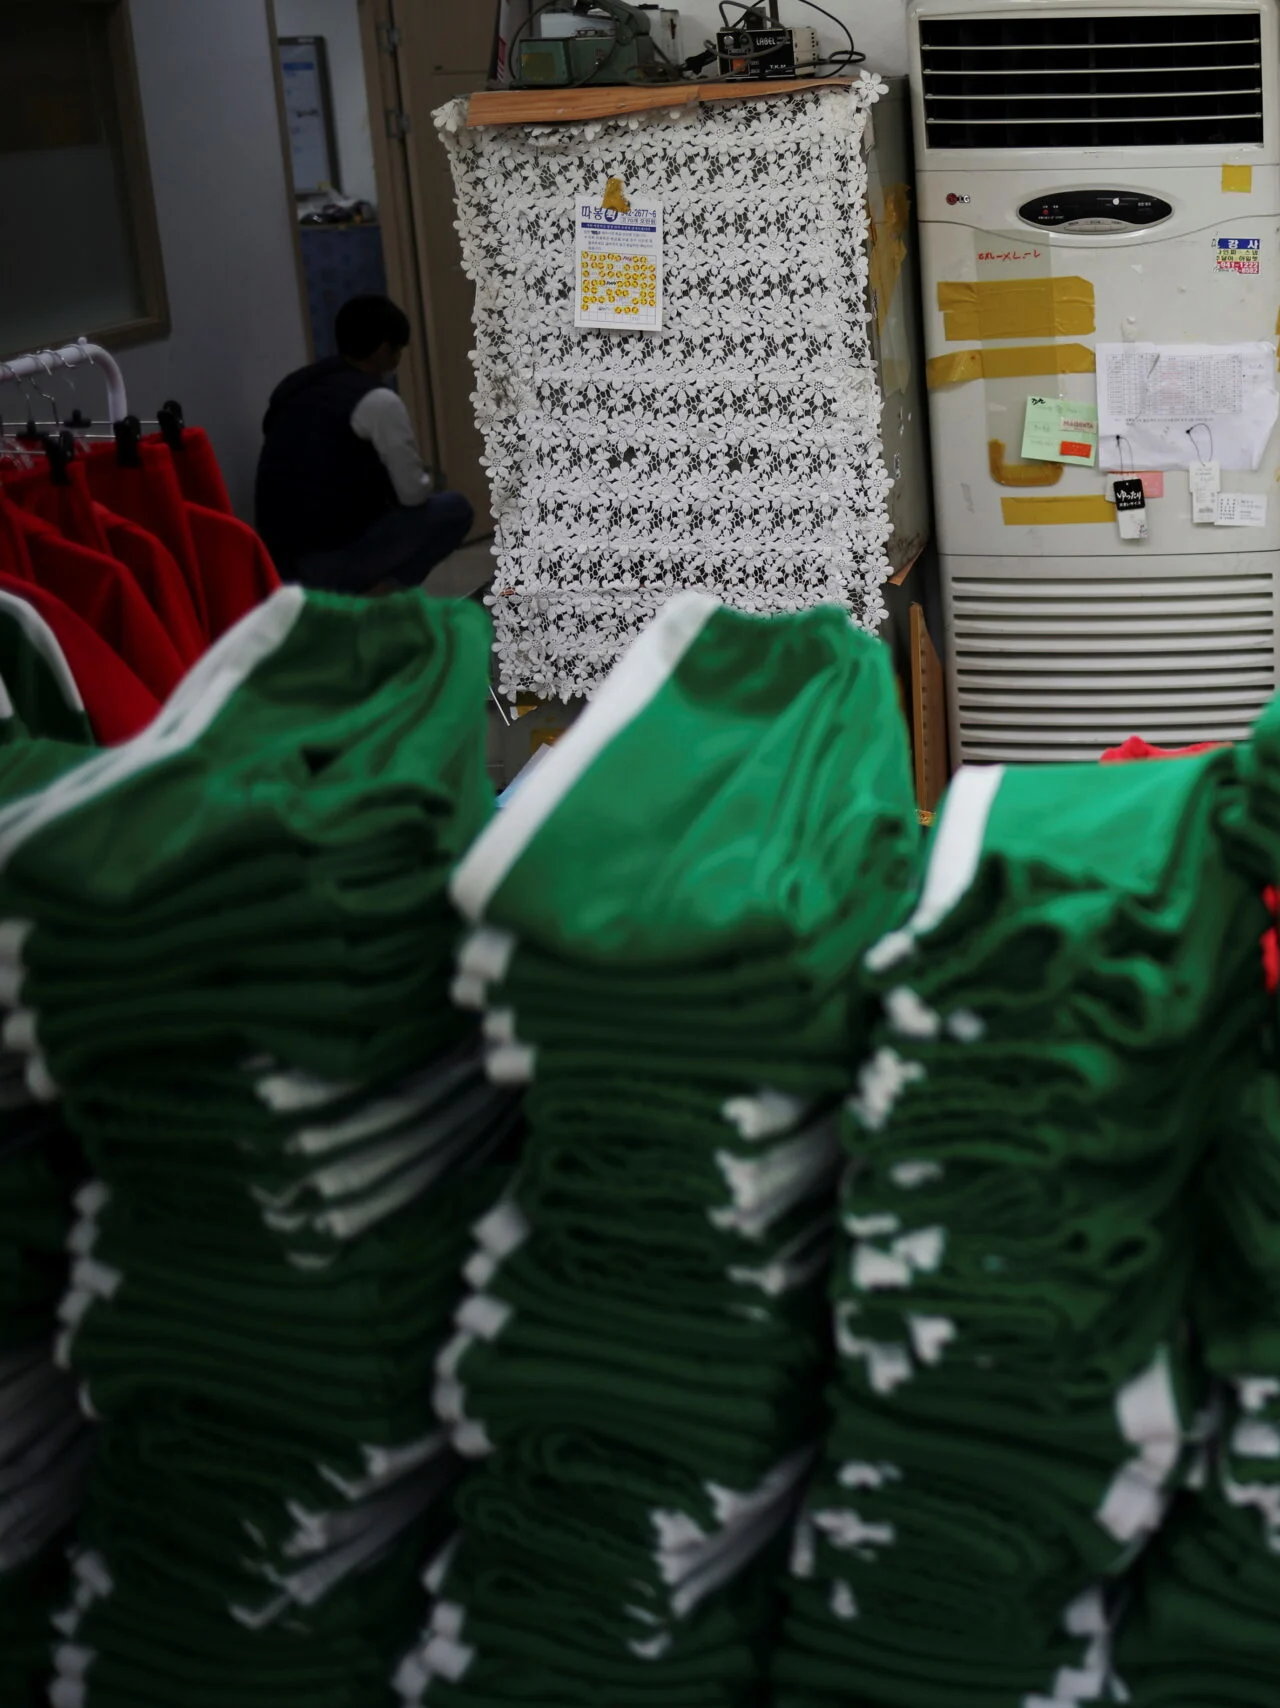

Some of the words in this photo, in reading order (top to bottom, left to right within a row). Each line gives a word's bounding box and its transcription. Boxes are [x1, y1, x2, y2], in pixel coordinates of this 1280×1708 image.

[756, 37, 776, 46] LABEL
[959, 195, 971, 203] LG
[581, 205, 603, 221] 따봉
[1063, 421, 1094, 429] MAGENTA
